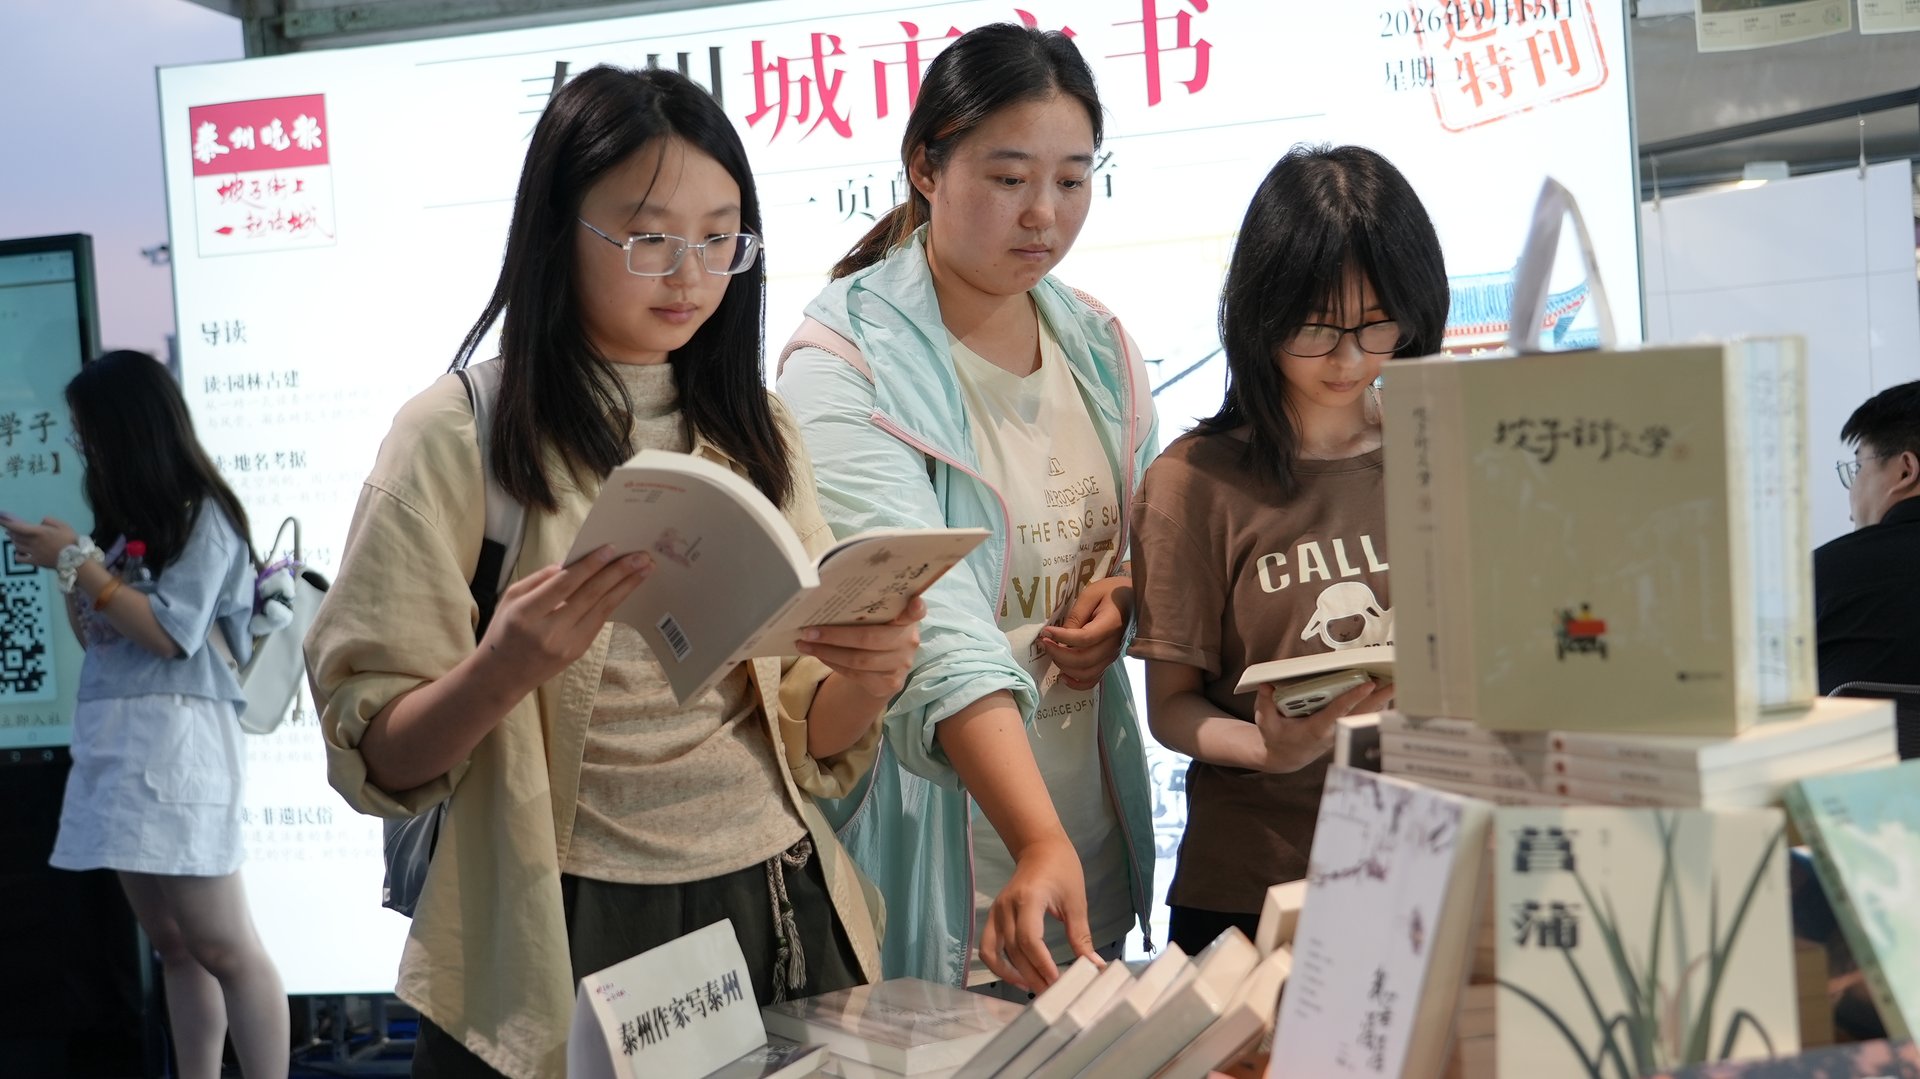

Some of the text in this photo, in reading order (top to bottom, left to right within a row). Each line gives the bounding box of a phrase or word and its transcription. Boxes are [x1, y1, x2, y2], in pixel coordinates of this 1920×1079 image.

[1458, 19, 1581, 108] 特刊
[194, 114, 322, 164] 泰州晚报
[201, 320, 248, 346] 导读
[0, 451, 61, 478] 学社】
[1017, 522, 1051, 545] THE
[1256, 534, 1391, 594] CALL
[1508, 825, 1580, 948] 菖蒲
[619, 969, 744, 1056] 泰州作家写泰州
